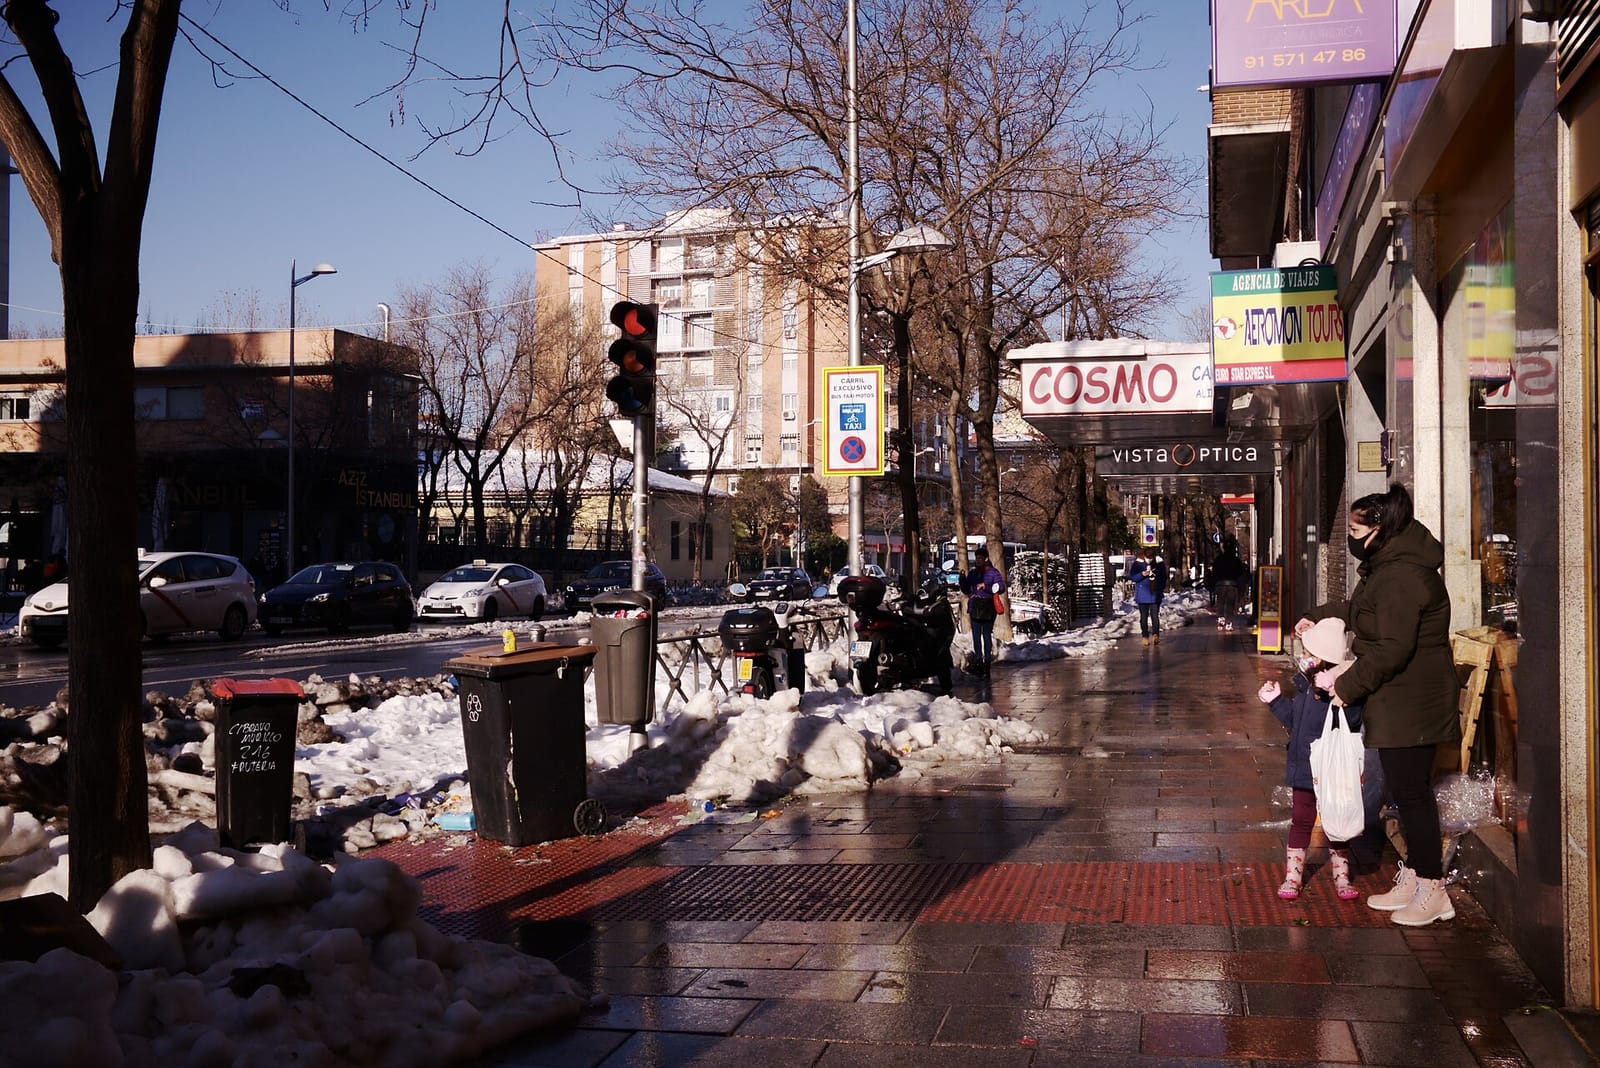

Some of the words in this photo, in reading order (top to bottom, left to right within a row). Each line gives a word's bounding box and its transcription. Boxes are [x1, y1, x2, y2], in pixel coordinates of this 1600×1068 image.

[1244, 56, 1264, 69] 91
[1273, 53, 1305, 67] 571
[1312, 50, 1337, 64] 47
[1342, 48, 1366, 62] 86
[1232, 273, 1272, 291] AGENCIA
[1273, 273, 1286, 288] DE
[1288, 270, 1320, 288] VIAJES
[1306, 303, 1344, 343] TOURS
[1029, 363, 1178, 405] COSMO
[1215, 368, 1229, 382] EURO
[1231, 367, 1244, 380] STAR
[1244, 366, 1264, 380] EXPRES
[240, 745, 270, 759] 216
